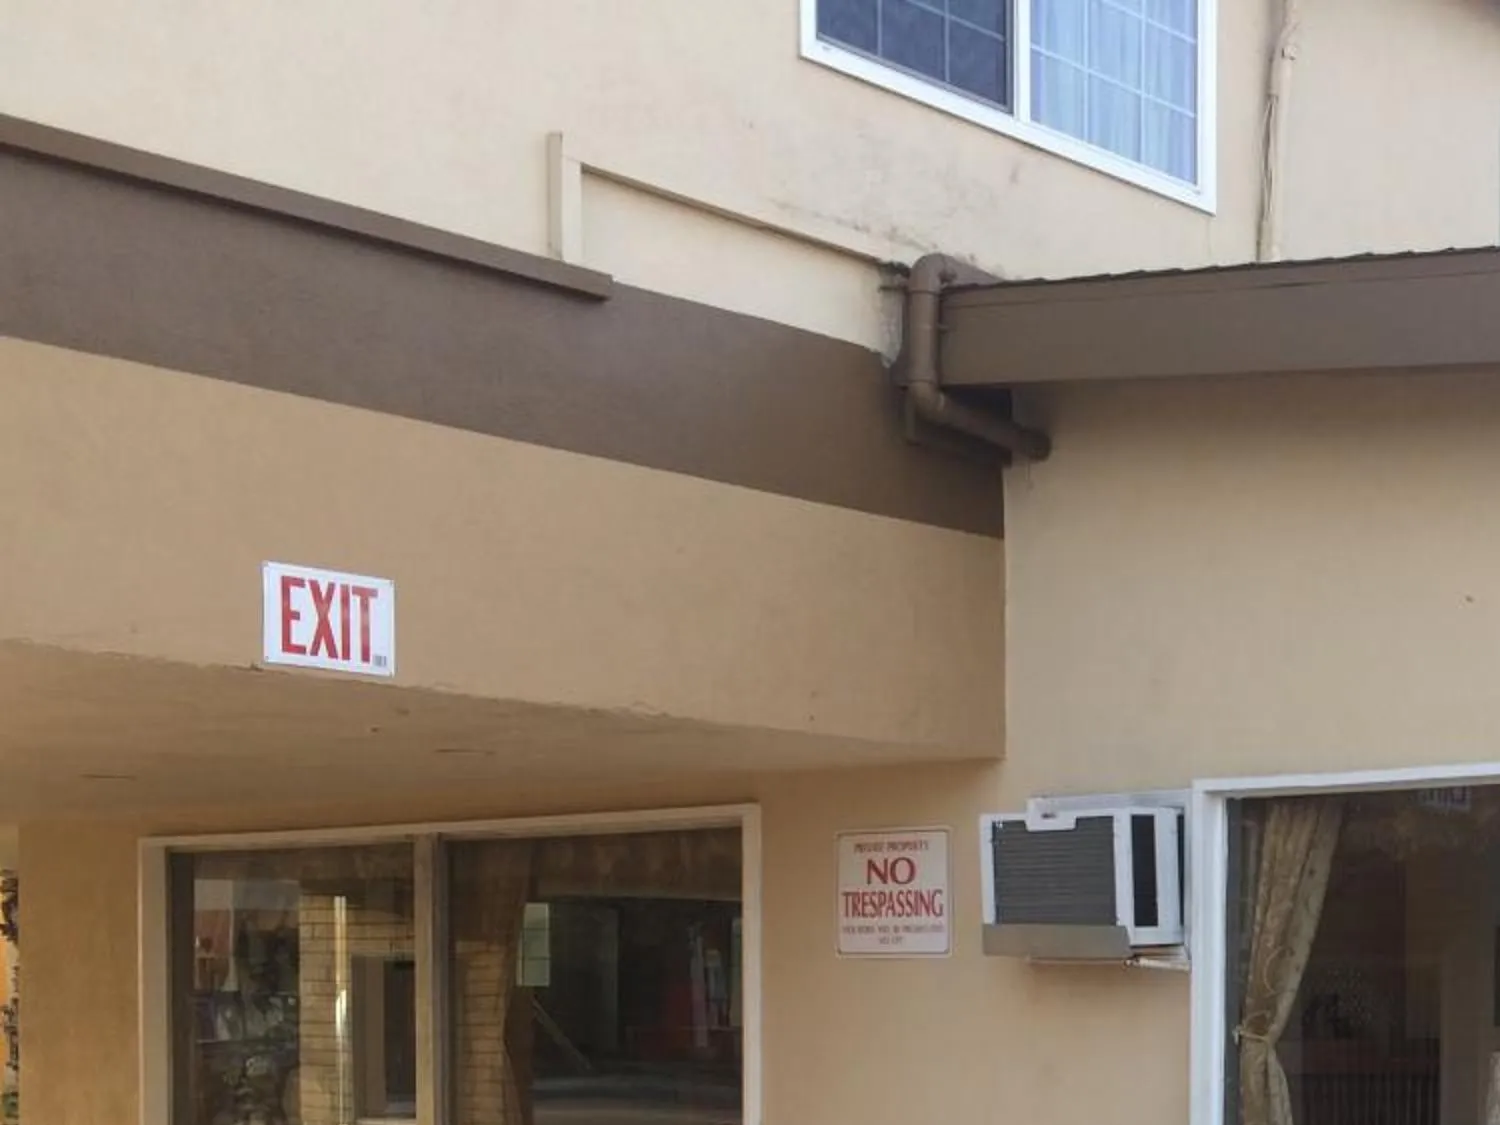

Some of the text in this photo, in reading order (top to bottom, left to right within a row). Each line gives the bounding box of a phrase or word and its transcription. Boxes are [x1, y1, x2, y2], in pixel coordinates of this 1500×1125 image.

[281, 576, 378, 664] EXIT
[866, 857, 916, 885] NO
[842, 889, 944, 918] TRESPASSING
